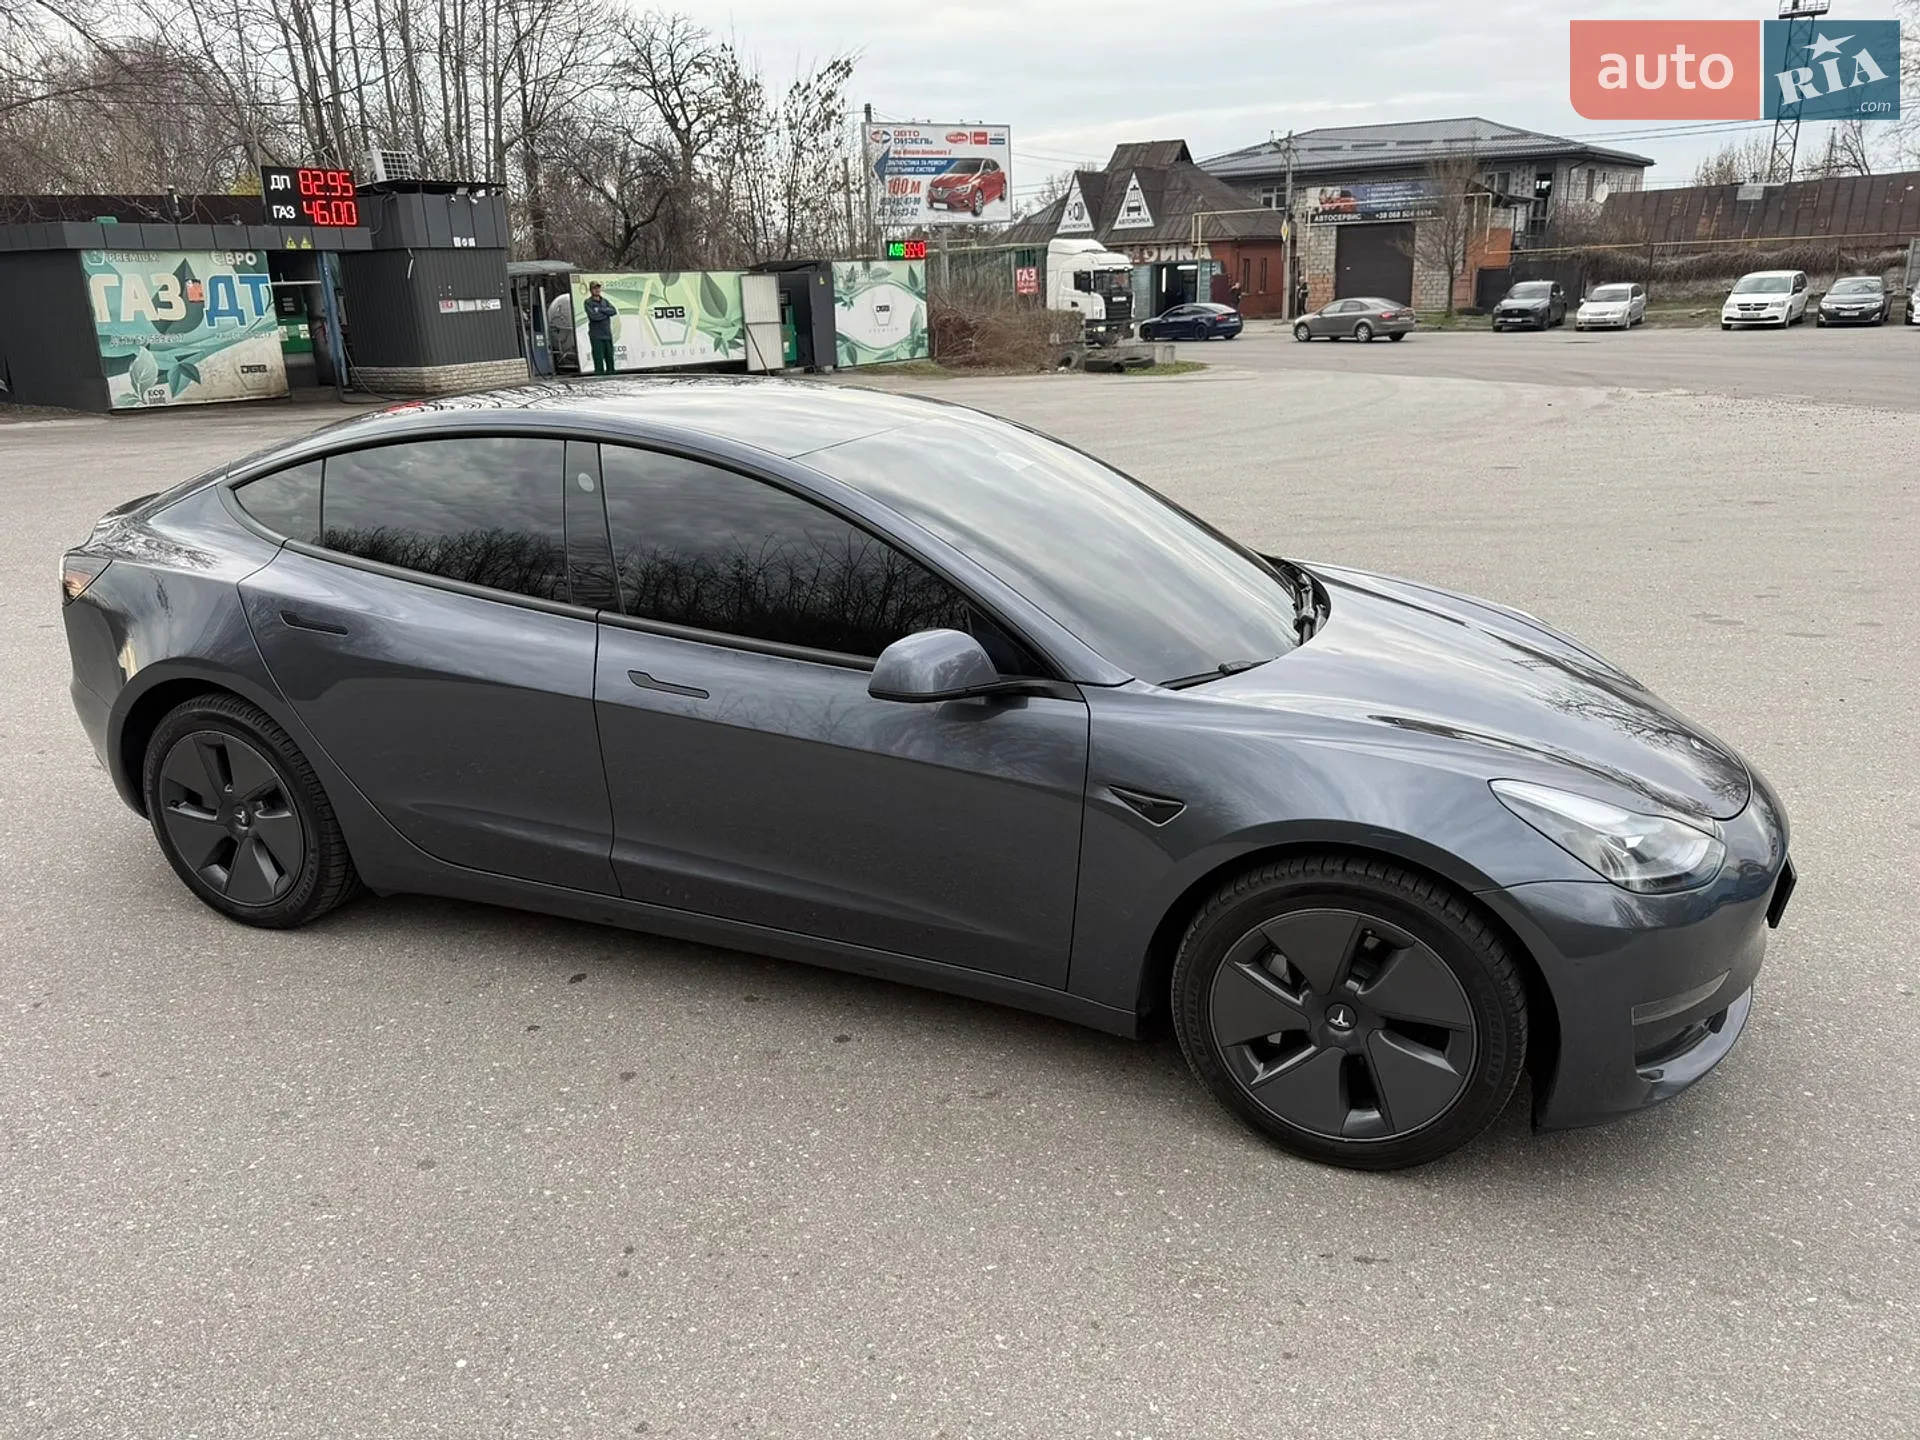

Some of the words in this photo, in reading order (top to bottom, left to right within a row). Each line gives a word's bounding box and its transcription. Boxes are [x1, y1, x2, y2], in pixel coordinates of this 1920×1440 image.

[270, 174, 291, 191] ДП
[298, 169, 354, 197] 82.95
[887, 178, 909, 195] 100
[272, 205, 296, 219] ГАЗ
[302, 200, 357, 225] 46.00
[109, 252, 159, 263] PREMIUM
[1016, 268, 1037, 282] ГАЗ
[88, 273, 187, 323] ГАЗ
[203, 273, 271, 327] ДТ
[640, 347, 705, 359] PREMIUM
[147, 389, 165, 397] ECO
